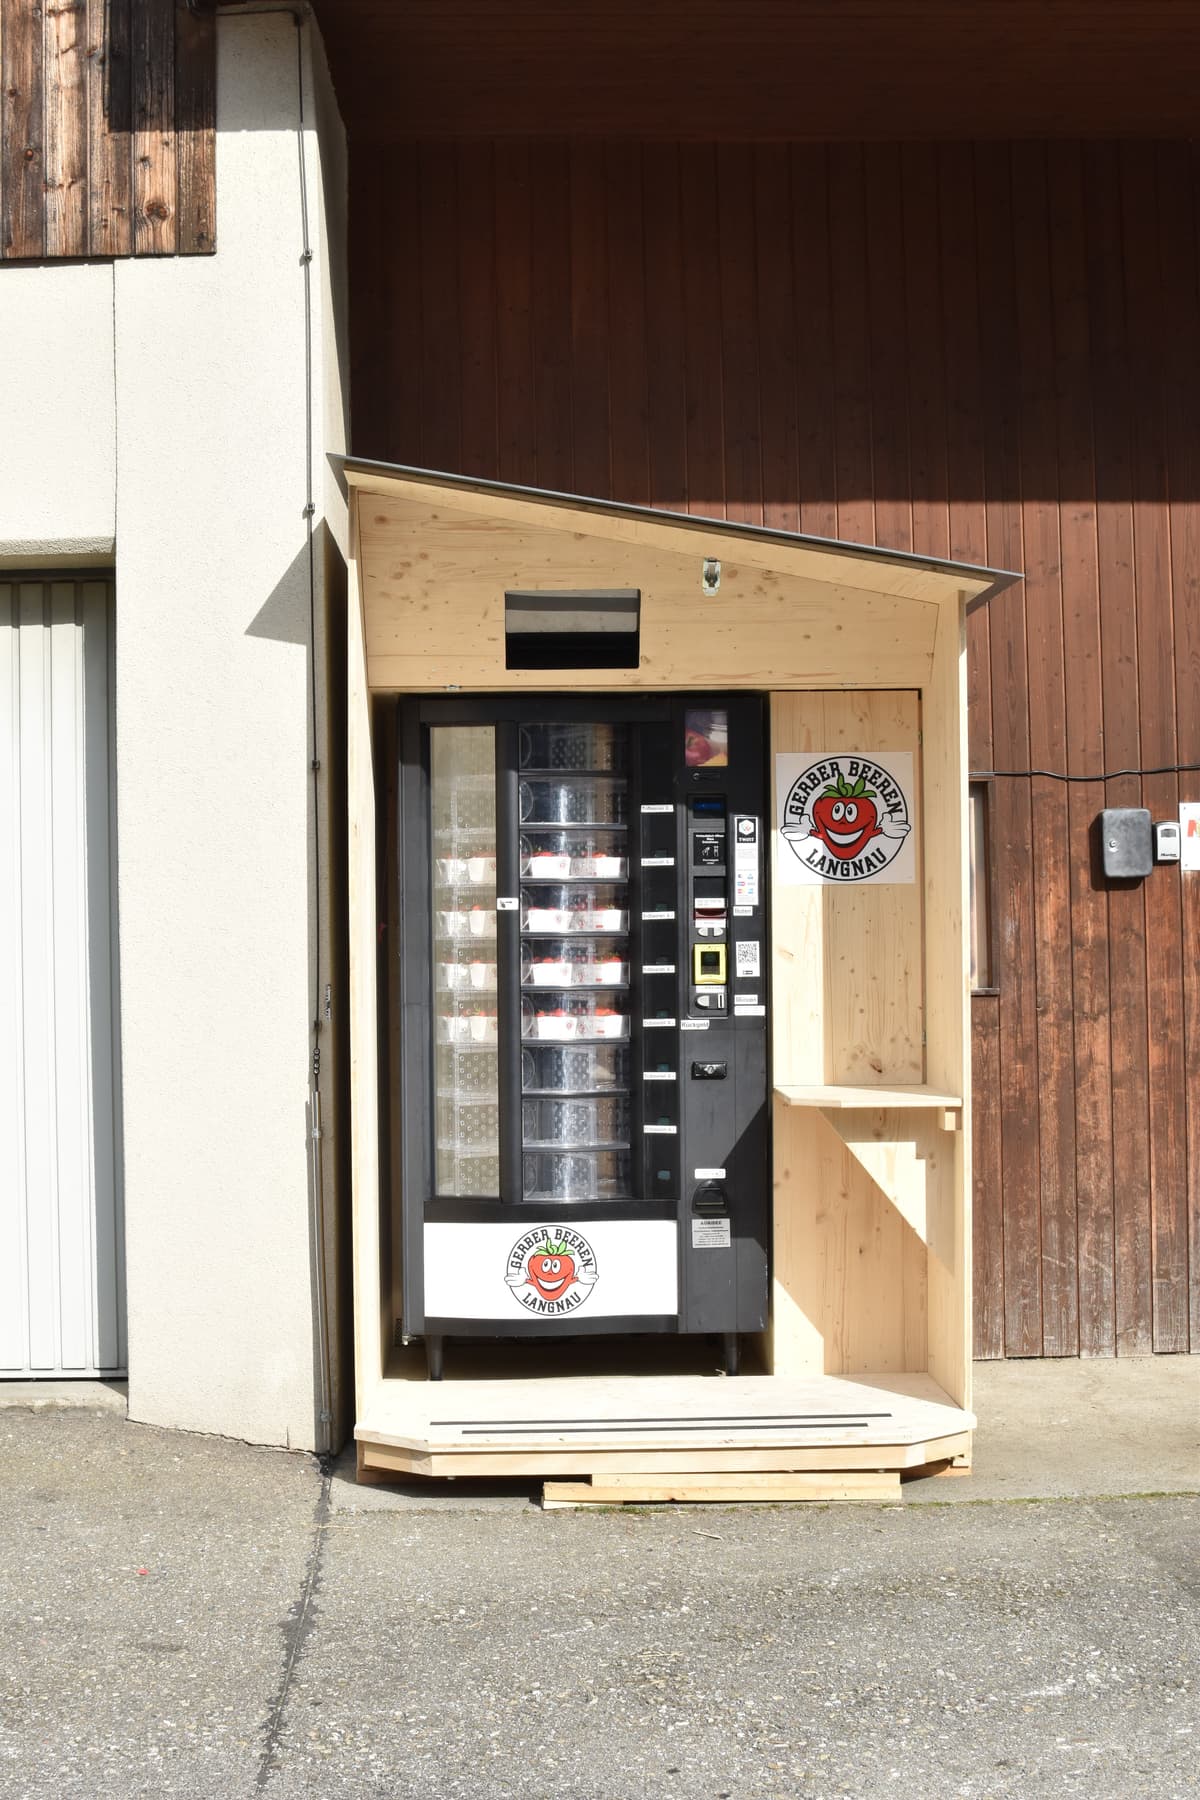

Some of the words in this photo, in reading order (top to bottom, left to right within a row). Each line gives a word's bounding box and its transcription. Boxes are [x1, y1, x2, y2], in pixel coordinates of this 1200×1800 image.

[789, 761, 842, 816] GERBER
[848, 761, 903, 815] BEEREN
[806, 847, 888, 877] LANGNAU
[510, 1228, 551, 1269] GERBER
[554, 1228, 594, 1268] BEEREN
[522, 1291, 582, 1313] LANGNAU
